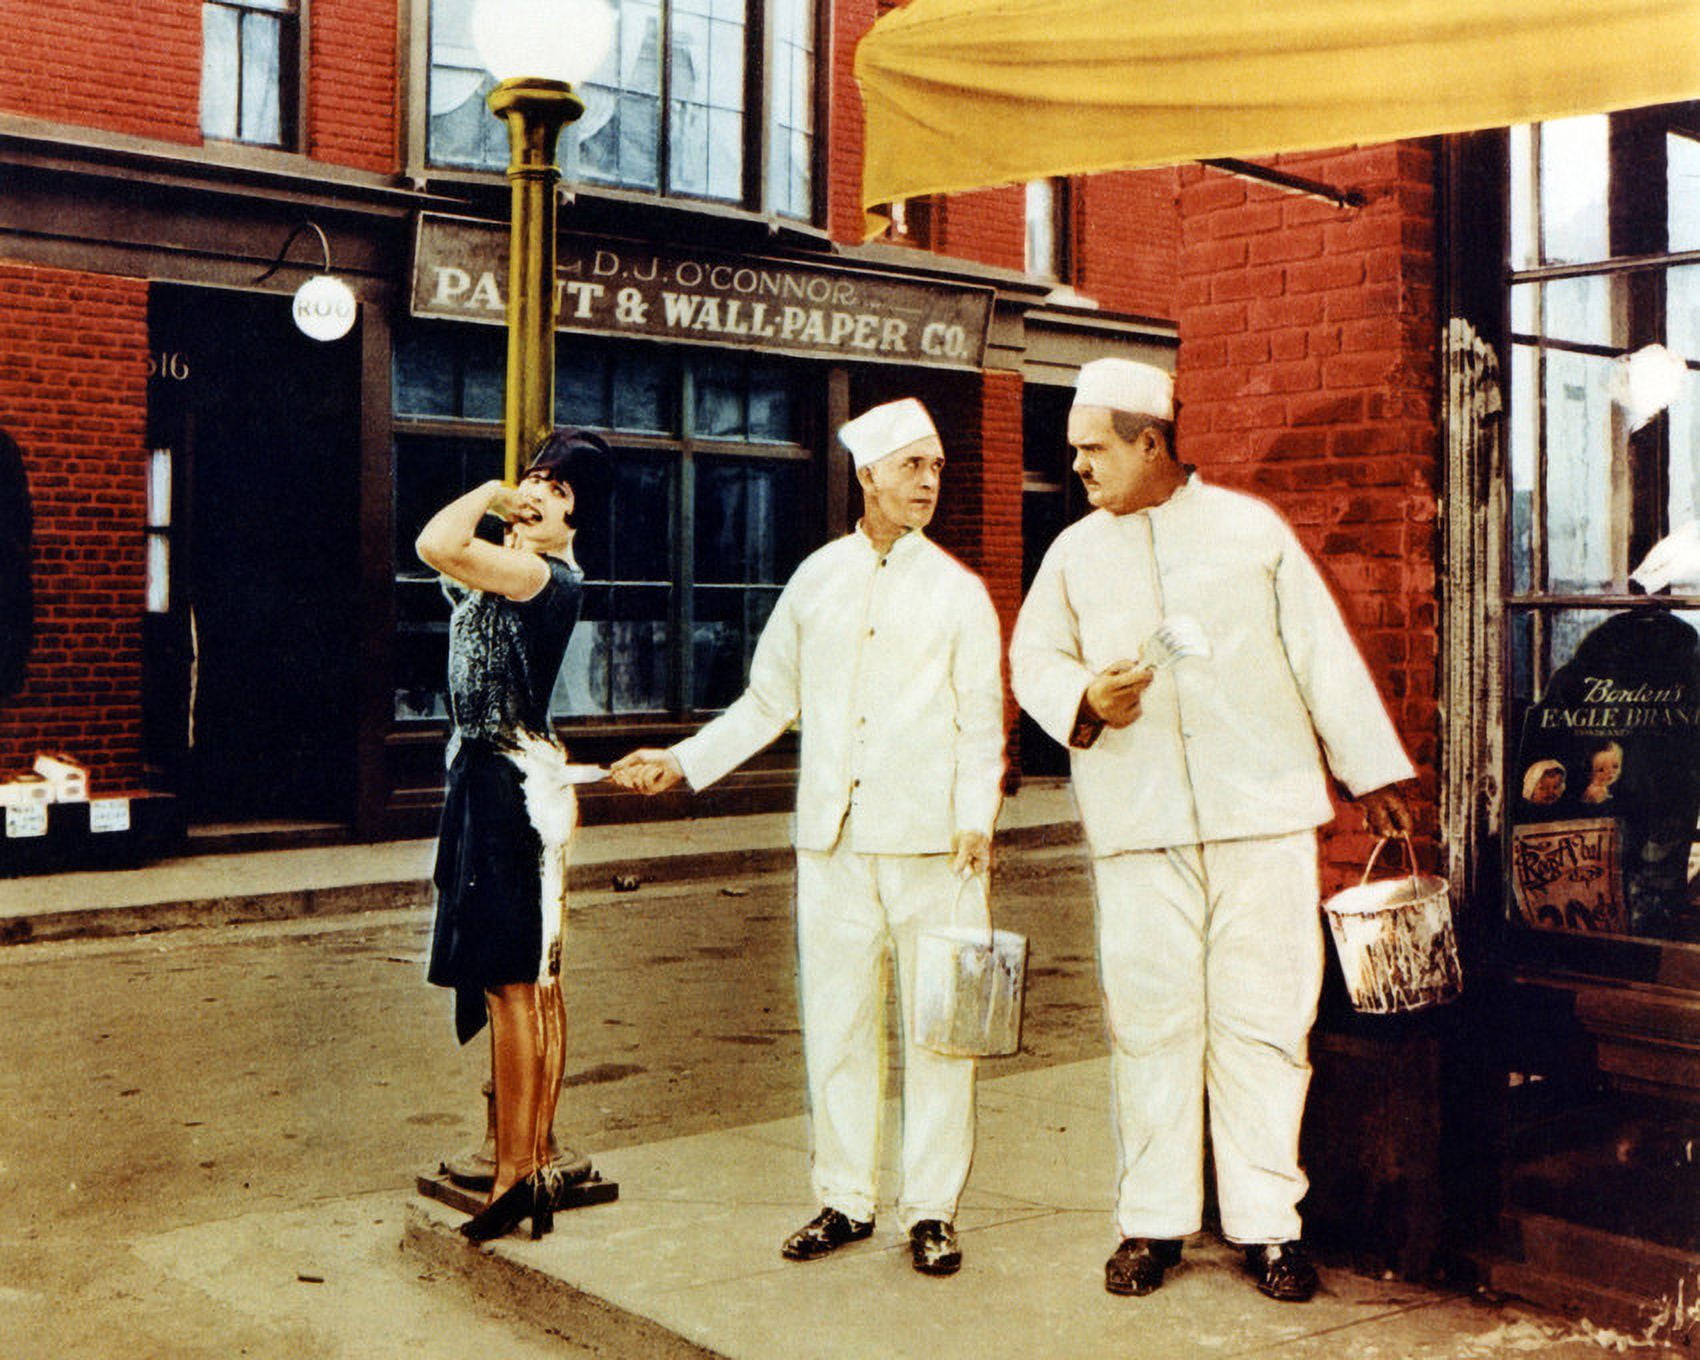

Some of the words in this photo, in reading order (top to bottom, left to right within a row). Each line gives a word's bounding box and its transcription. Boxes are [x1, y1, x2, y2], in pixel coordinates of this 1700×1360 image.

[427, 266, 604, 319] PAT
[615, 287, 649, 324] &
[1541, 708, 1619, 728] EAGLE
